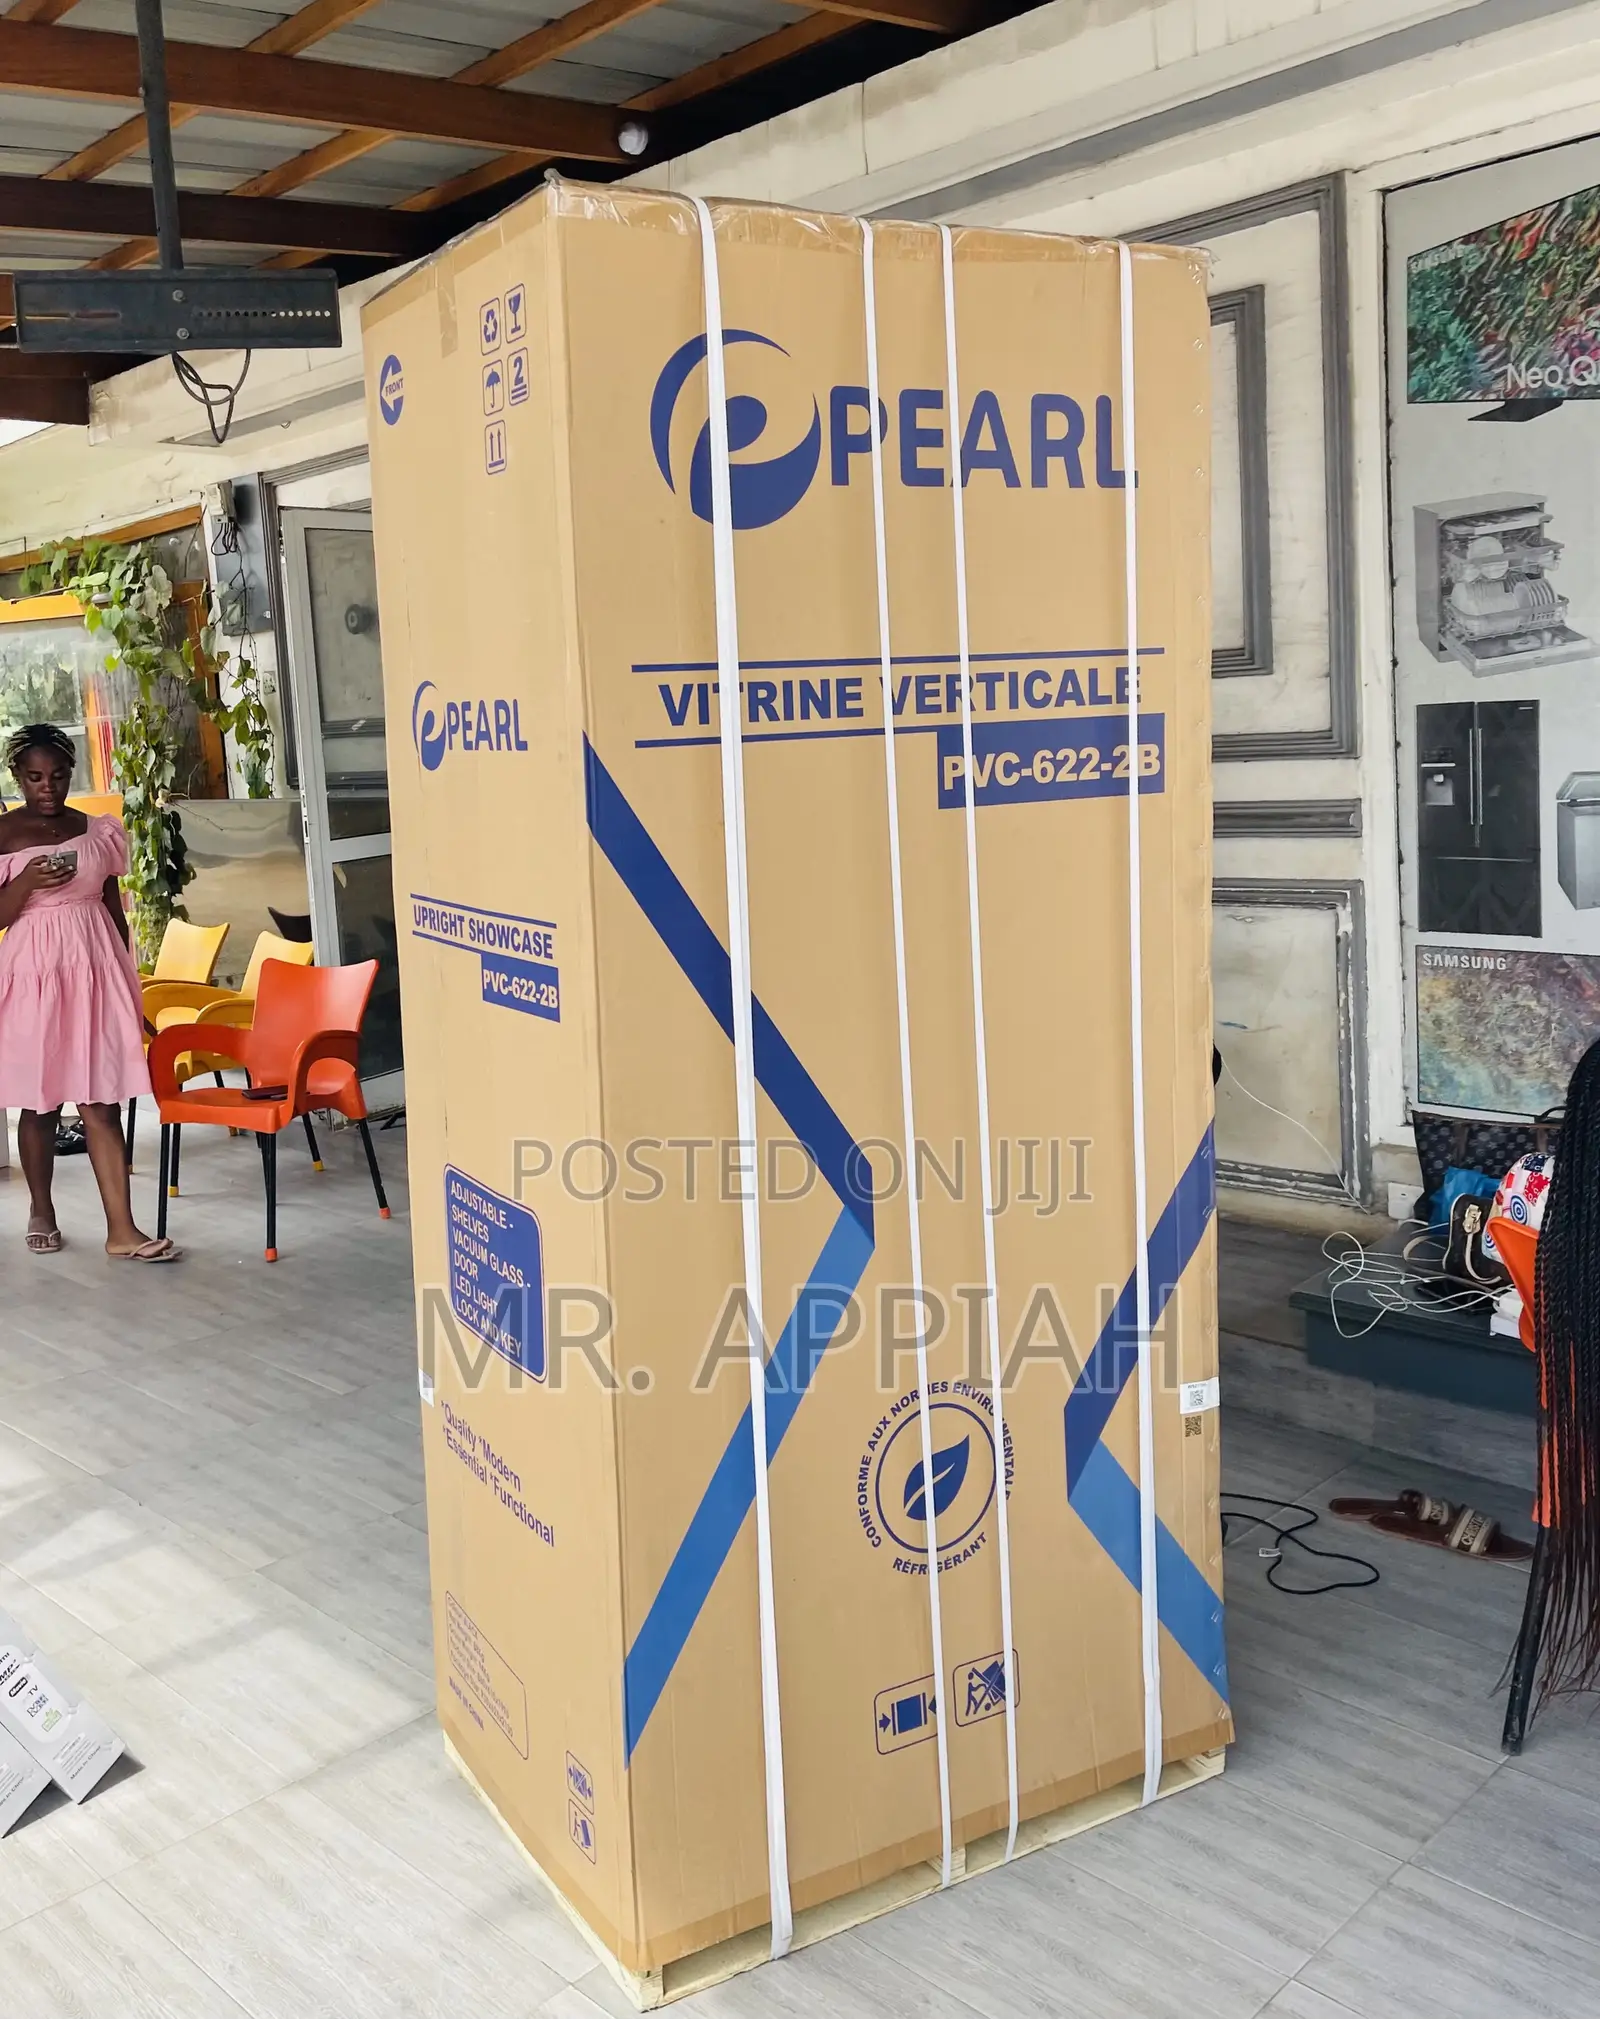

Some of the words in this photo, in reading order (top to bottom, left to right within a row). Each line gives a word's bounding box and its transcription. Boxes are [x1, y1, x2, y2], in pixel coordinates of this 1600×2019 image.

[385, 377, 404, 397] FRONT
[830, 385, 1139, 488] PEARL
[658, 677, 864, 726] VIRINE
[879, 666, 1141, 716] VERTICALE
[446, 698, 528, 751] PEARL
[943, 743, 1161, 791] PVC-622-2B
[413, 904, 465, 938] UPRIGHT
[468, 917, 553, 960] SHOWCASE
[1422, 952, 1507, 970] SAMSUNG
[483, 968, 558, 1009] PVC-622-2B
[451, 1180, 507, 1229] ADJUSTABLE
[451, 1204, 489, 1243] SHELVES
[453, 1226, 488, 1265] VACUUM
[490, 1253, 524, 1287] GLASS
[454, 1249, 478, 1281] DOOR
[455, 1272, 471, 1297] LED
[473, 1285, 498, 1318] LIGHT
[456, 1294, 479, 1327] LOCK
[481, 1315, 499, 1342] AND
[501, 1330, 521, 1358] KEY
[890, 1381, 949, 1418] NORES
[867, 1416, 892, 1452] AUX
[858, 1454, 882, 1548] CONFORME
[892, 1531, 988, 1576] RÉFRGÉRANT
